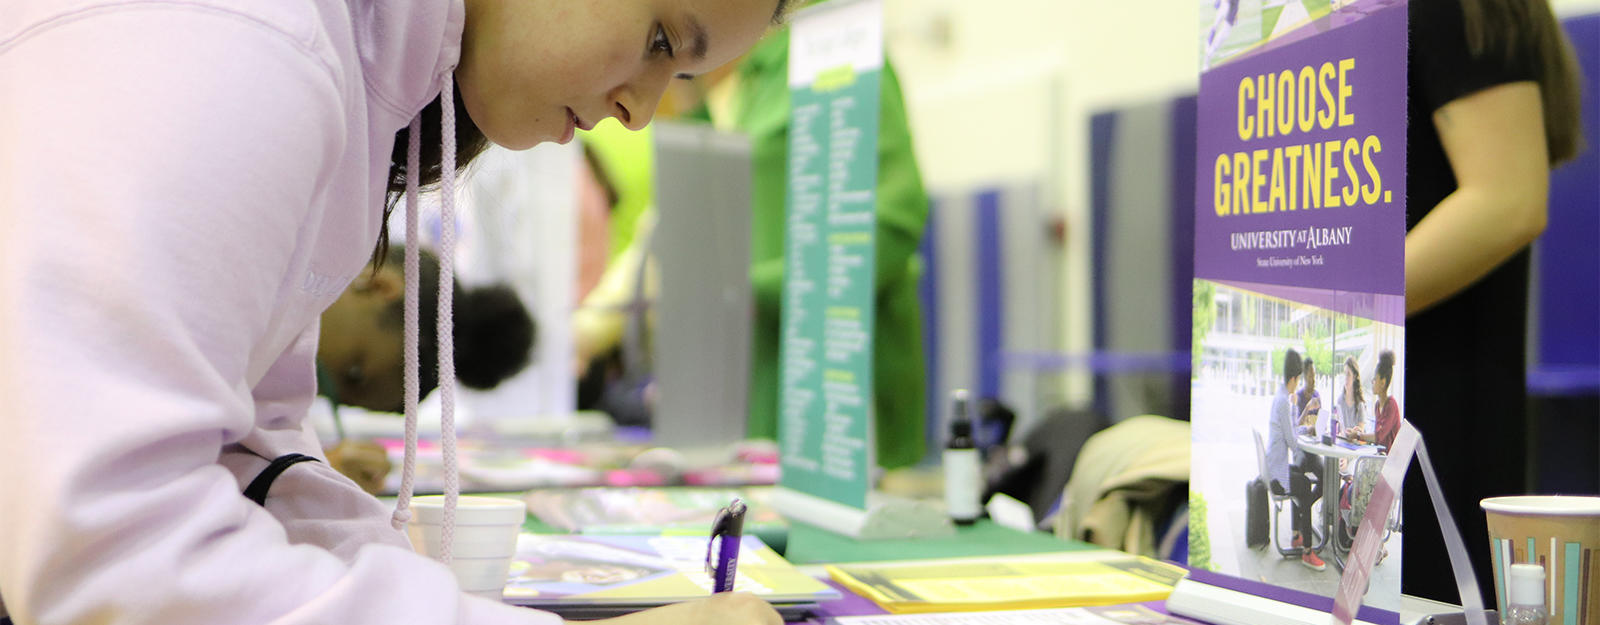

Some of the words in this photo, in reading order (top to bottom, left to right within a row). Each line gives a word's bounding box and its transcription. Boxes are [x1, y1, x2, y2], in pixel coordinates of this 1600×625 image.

[1238, 58, 1355, 140] CHOOSE
[1214, 134, 1392, 217] GREATNESS.
[1231, 230, 1296, 250] UNIVERSITY
[1297, 230, 1306, 243] AT
[1306, 225, 1353, 249] ALBANY
[1257, 257, 1269, 267] State
[1269, 256, 1293, 269] University
[1293, 256, 1299, 266] of
[1299, 255, 1311, 265] New
[1311, 254, 1324, 265] York
